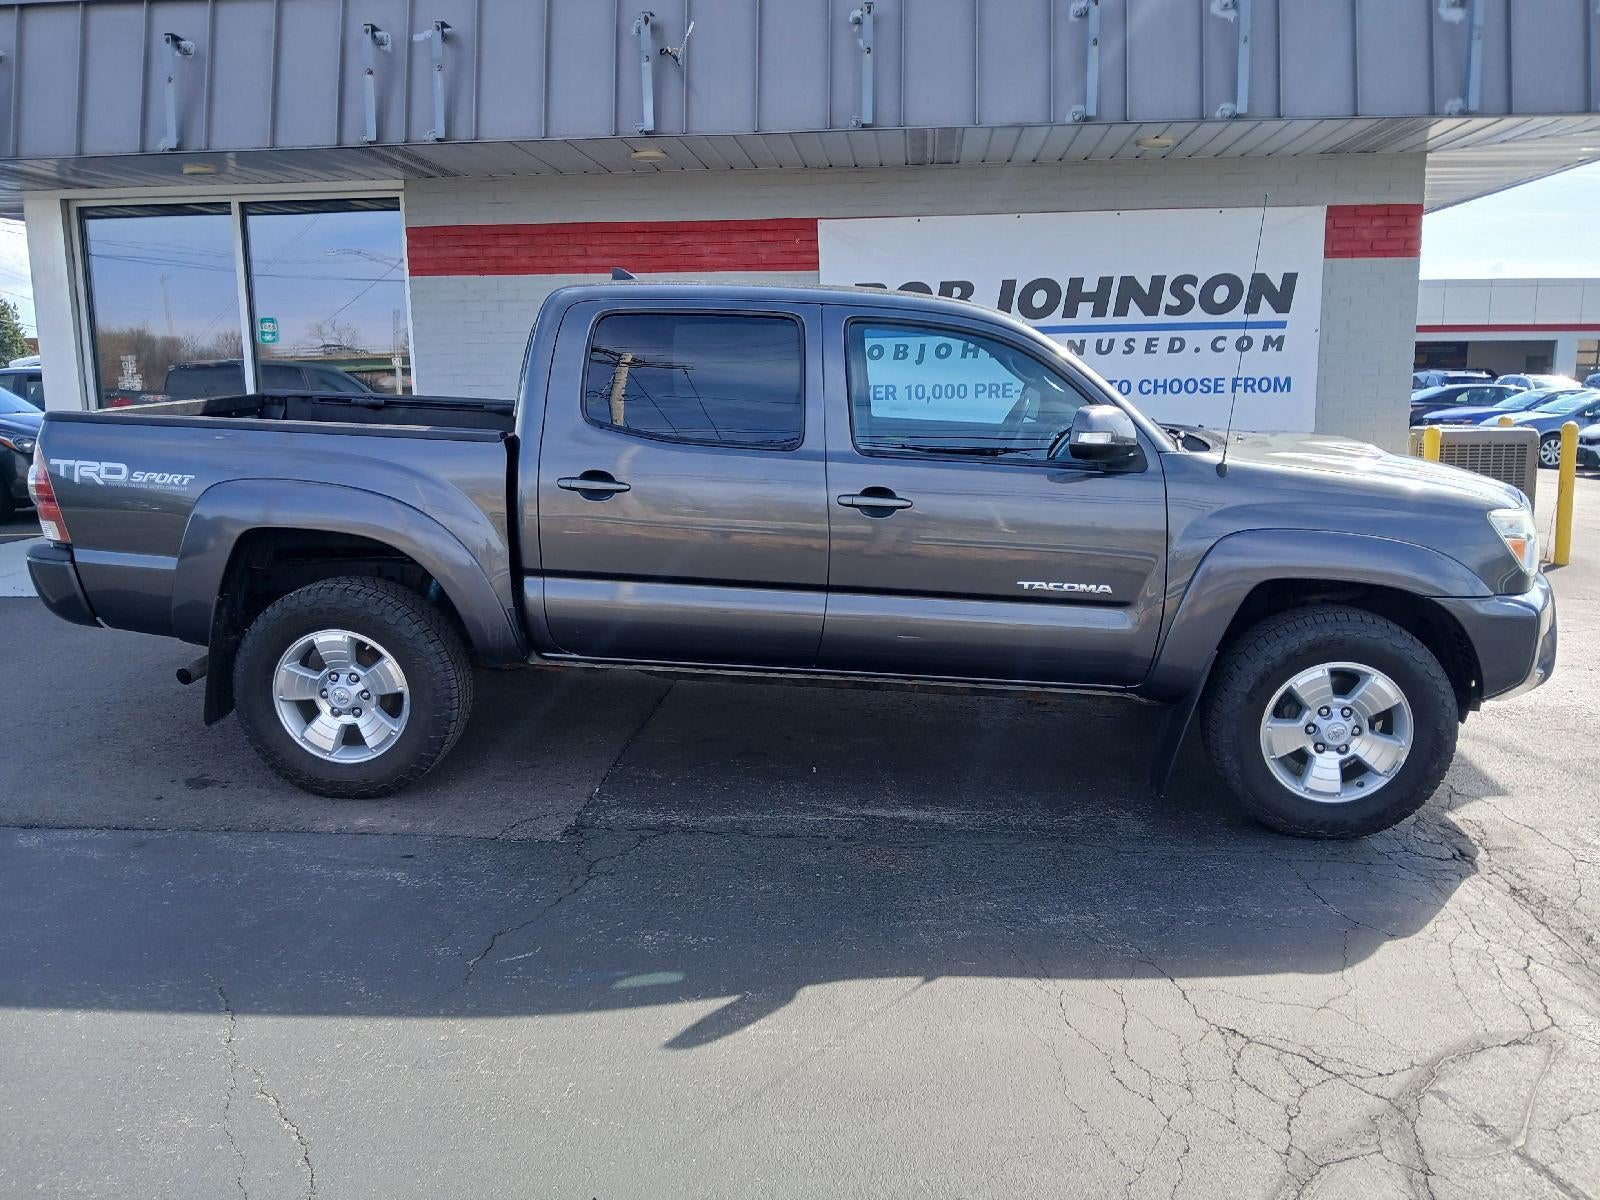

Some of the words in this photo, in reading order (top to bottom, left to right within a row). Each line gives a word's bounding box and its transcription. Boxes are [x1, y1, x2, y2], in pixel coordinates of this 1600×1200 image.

[997, 272, 1298, 319] JOHNSON
[904, 383, 968, 404] 10,000
[1138, 377, 1225, 396] CHOOSE
[1231, 376, 1292, 394] FROM
[50, 458, 128, 485] TRD
[130, 471, 196, 485] SPORT
[1017, 581, 1113, 594] TACOMA
